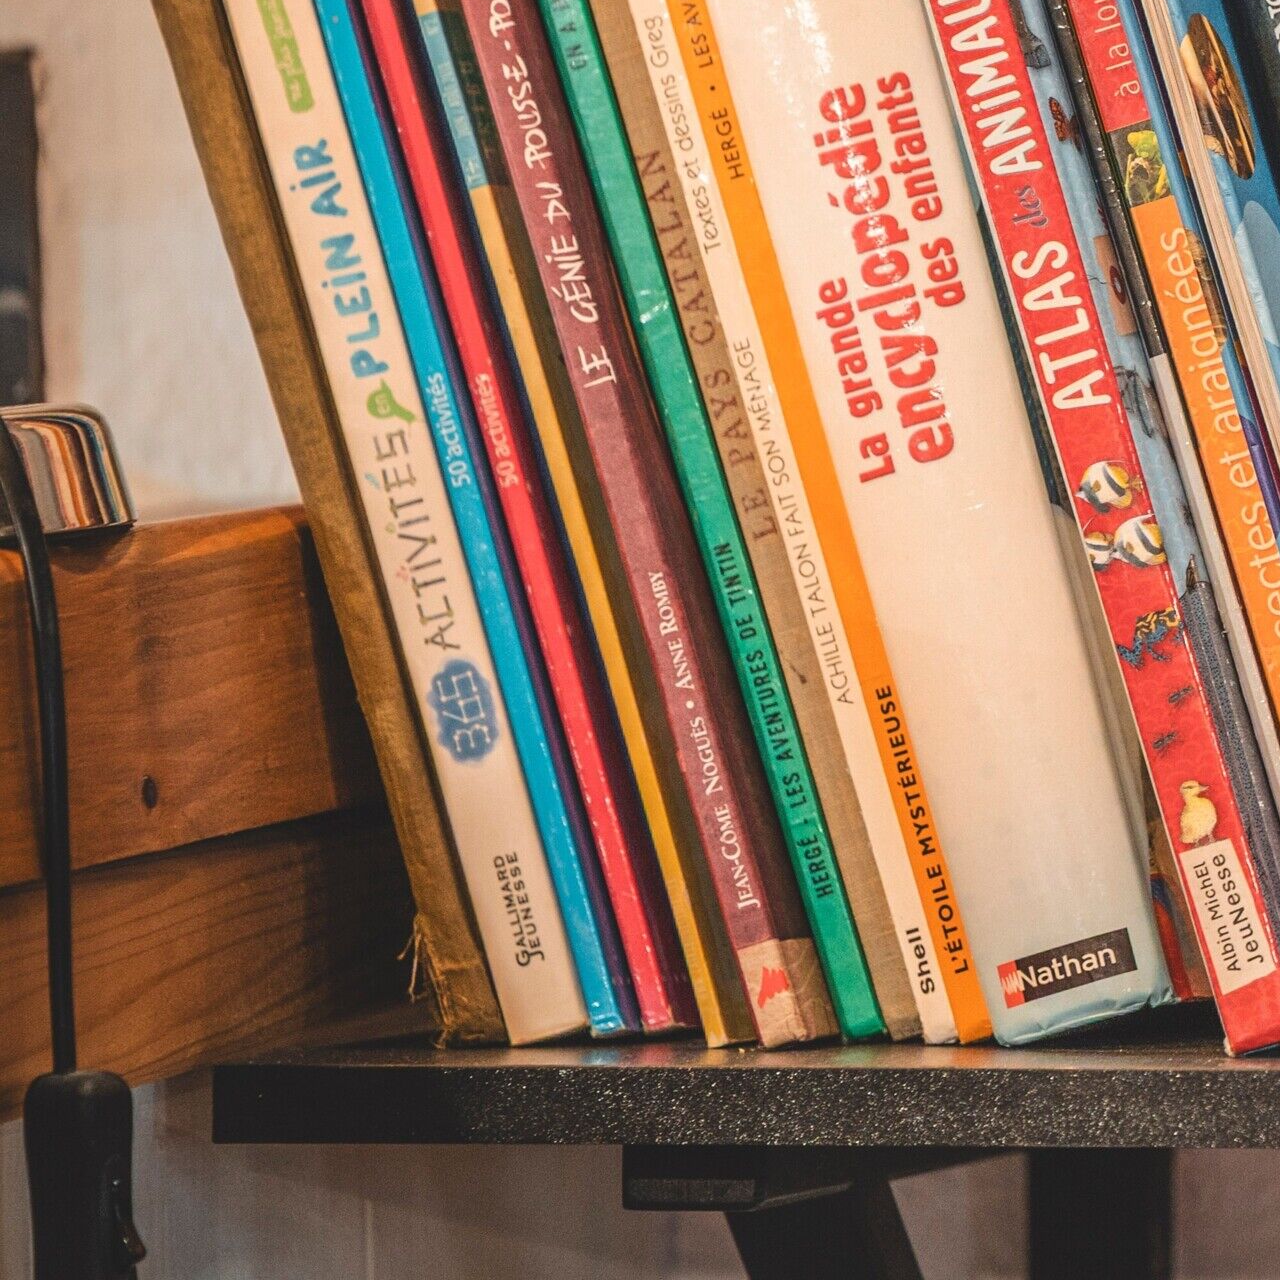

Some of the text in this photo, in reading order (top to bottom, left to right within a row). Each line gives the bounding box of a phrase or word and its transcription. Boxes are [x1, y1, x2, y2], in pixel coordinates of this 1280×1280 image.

[643, 15, 721, 255] Textes et dessins Greg
[690, 32, 714, 69] LES
[711, 107, 745, 180] HERGÉ
[1095, 34, 1136, 79] la
[534, 181, 617, 389] LE GÉNIE DU
[818, 82, 955, 471] encyclopédie
[876, 71, 967, 308] des enfants
[650, 151, 779, 542] LE PAYS CATALAN
[815, 277, 896, 484] La grande
[1011, 184, 1112, 410] ATLAS des
[1162, 227, 1241, 434] araignées
[289, 138, 492, 753] 365 ACTIVITÉS PLEIN AIR
[425, 372, 471, 488] 50 activités
[475, 372, 519, 488] 50 activités
[732, 337, 855, 705] ACHILLE TALON FAIT SON MÉNAGE
[1219, 437, 1258, 489] et
[713, 542, 834, 899] HERGÉ LES AVENTURES DE TINTIN
[875, 685, 969, 974] L'ÉTOILE MYSTÉRIEUSE
[905, 927, 935, 995] Shell
[1016, 940, 1117, 992] Nathan
[1217, 925, 1242, 971] Albin
